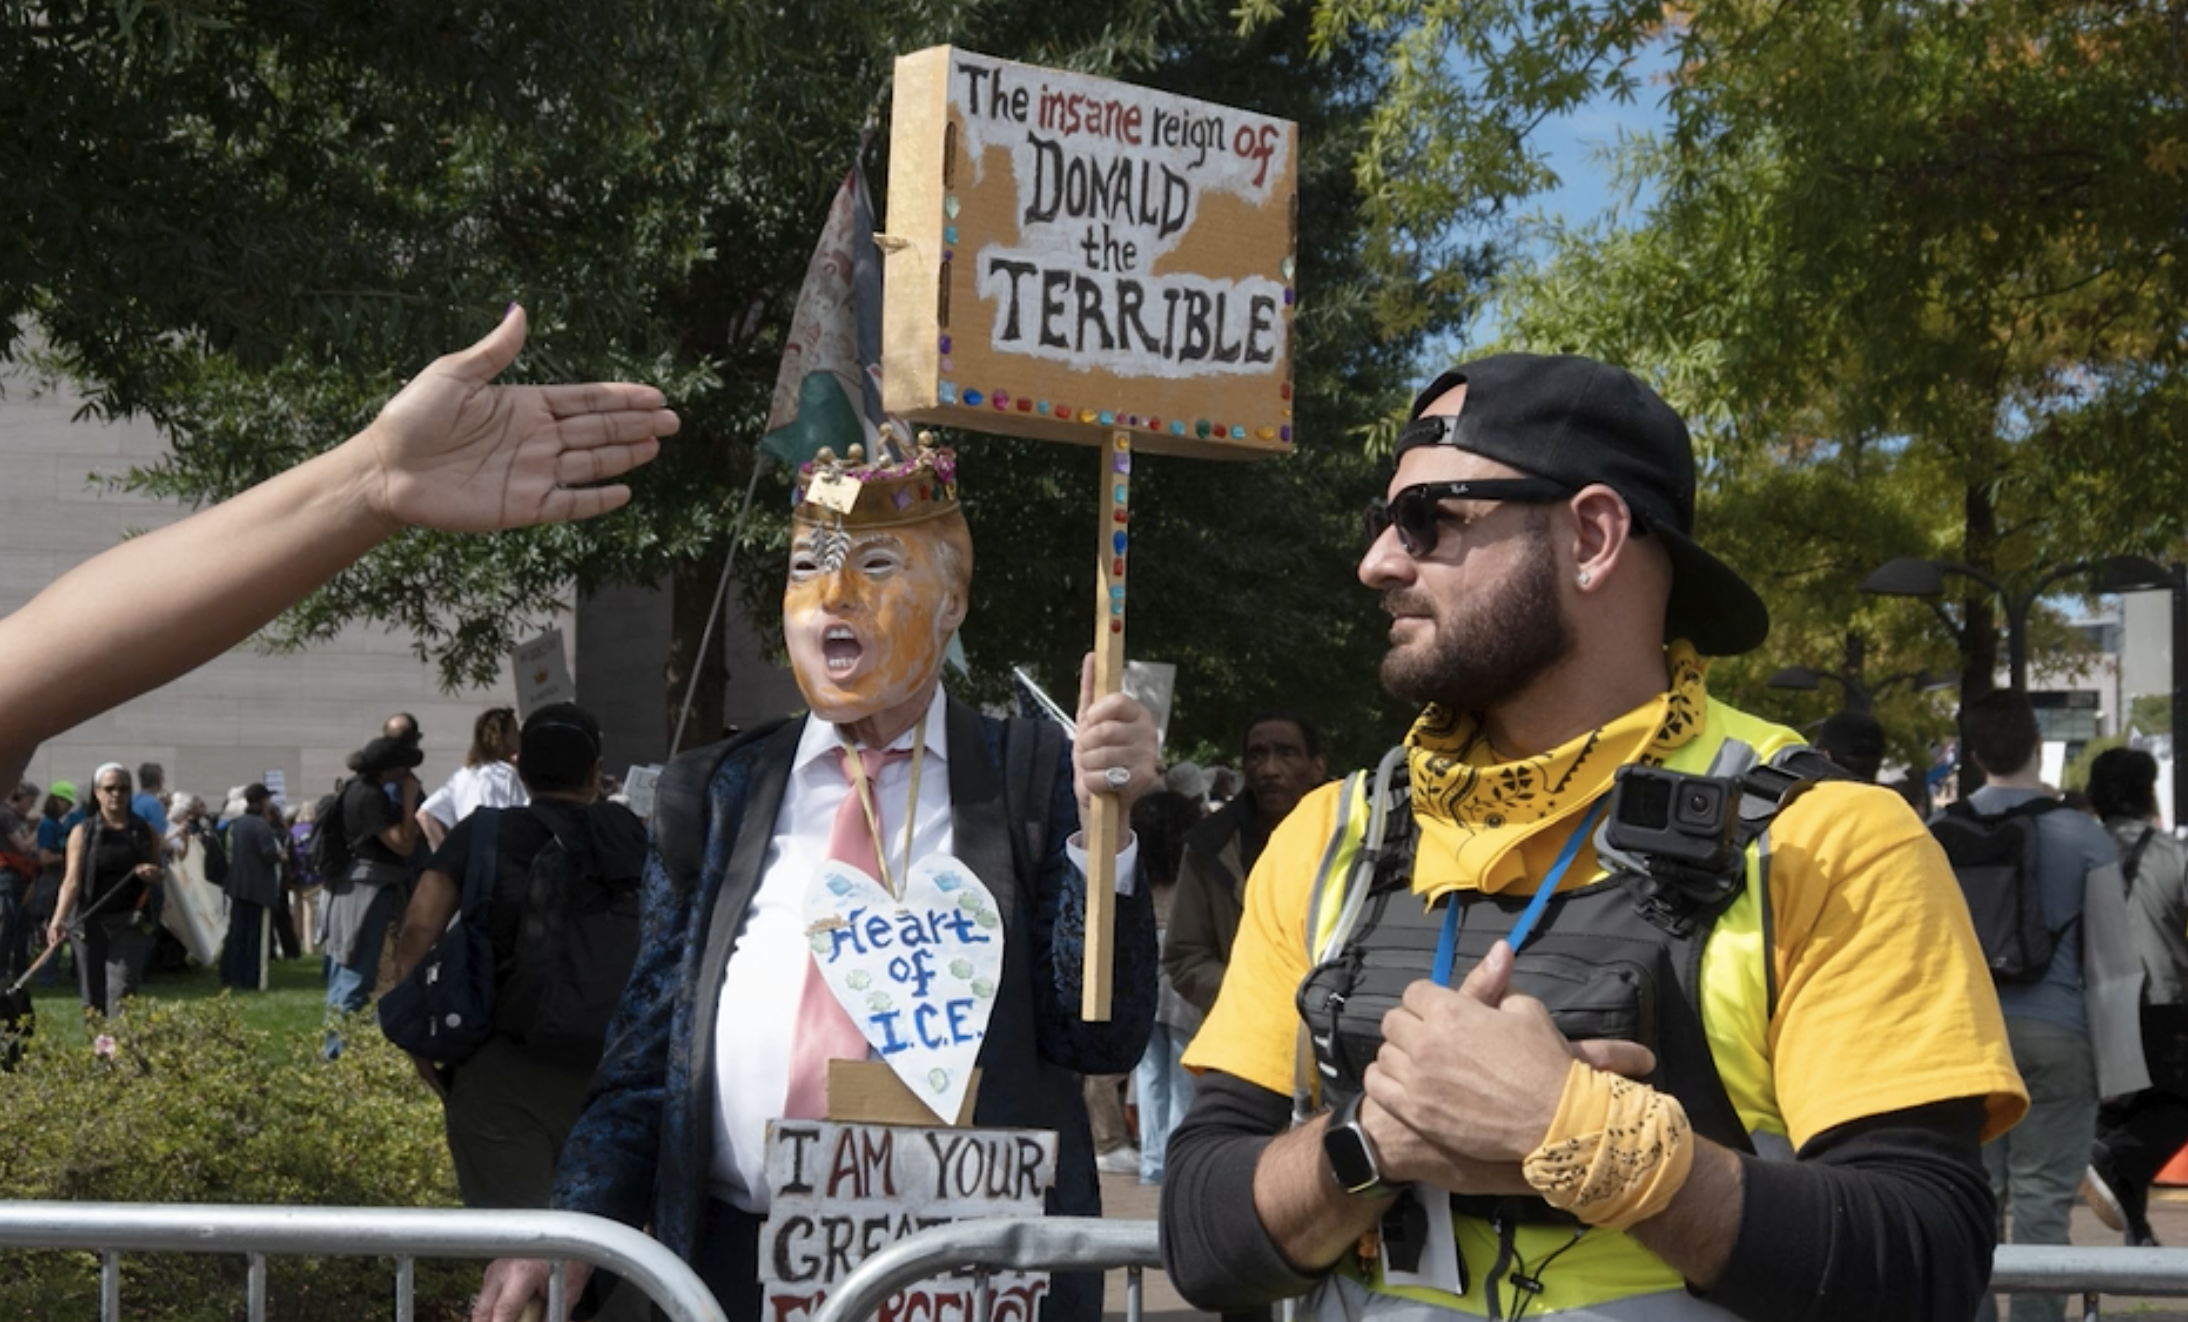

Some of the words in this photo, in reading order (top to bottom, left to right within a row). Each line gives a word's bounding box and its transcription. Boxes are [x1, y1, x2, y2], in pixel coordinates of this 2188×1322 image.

[957, 62, 1029, 121] The
[1039, 84, 1142, 145] insane
[1151, 105, 1227, 170] reign
[1233, 123, 1280, 188] of
[1024, 130, 1190, 239] DONALD
[1081, 224, 1138, 273] the
[989, 257, 1277, 364] TERRIBLE
[828, 906, 990, 963] Heart
[889, 949, 936, 997] of
[869, 999, 984, 1055] I.C.E.
[777, 1128, 820, 1197] I
[826, 1128, 896, 1198] AM
[927, 1131, 1045, 1199] YOUR
